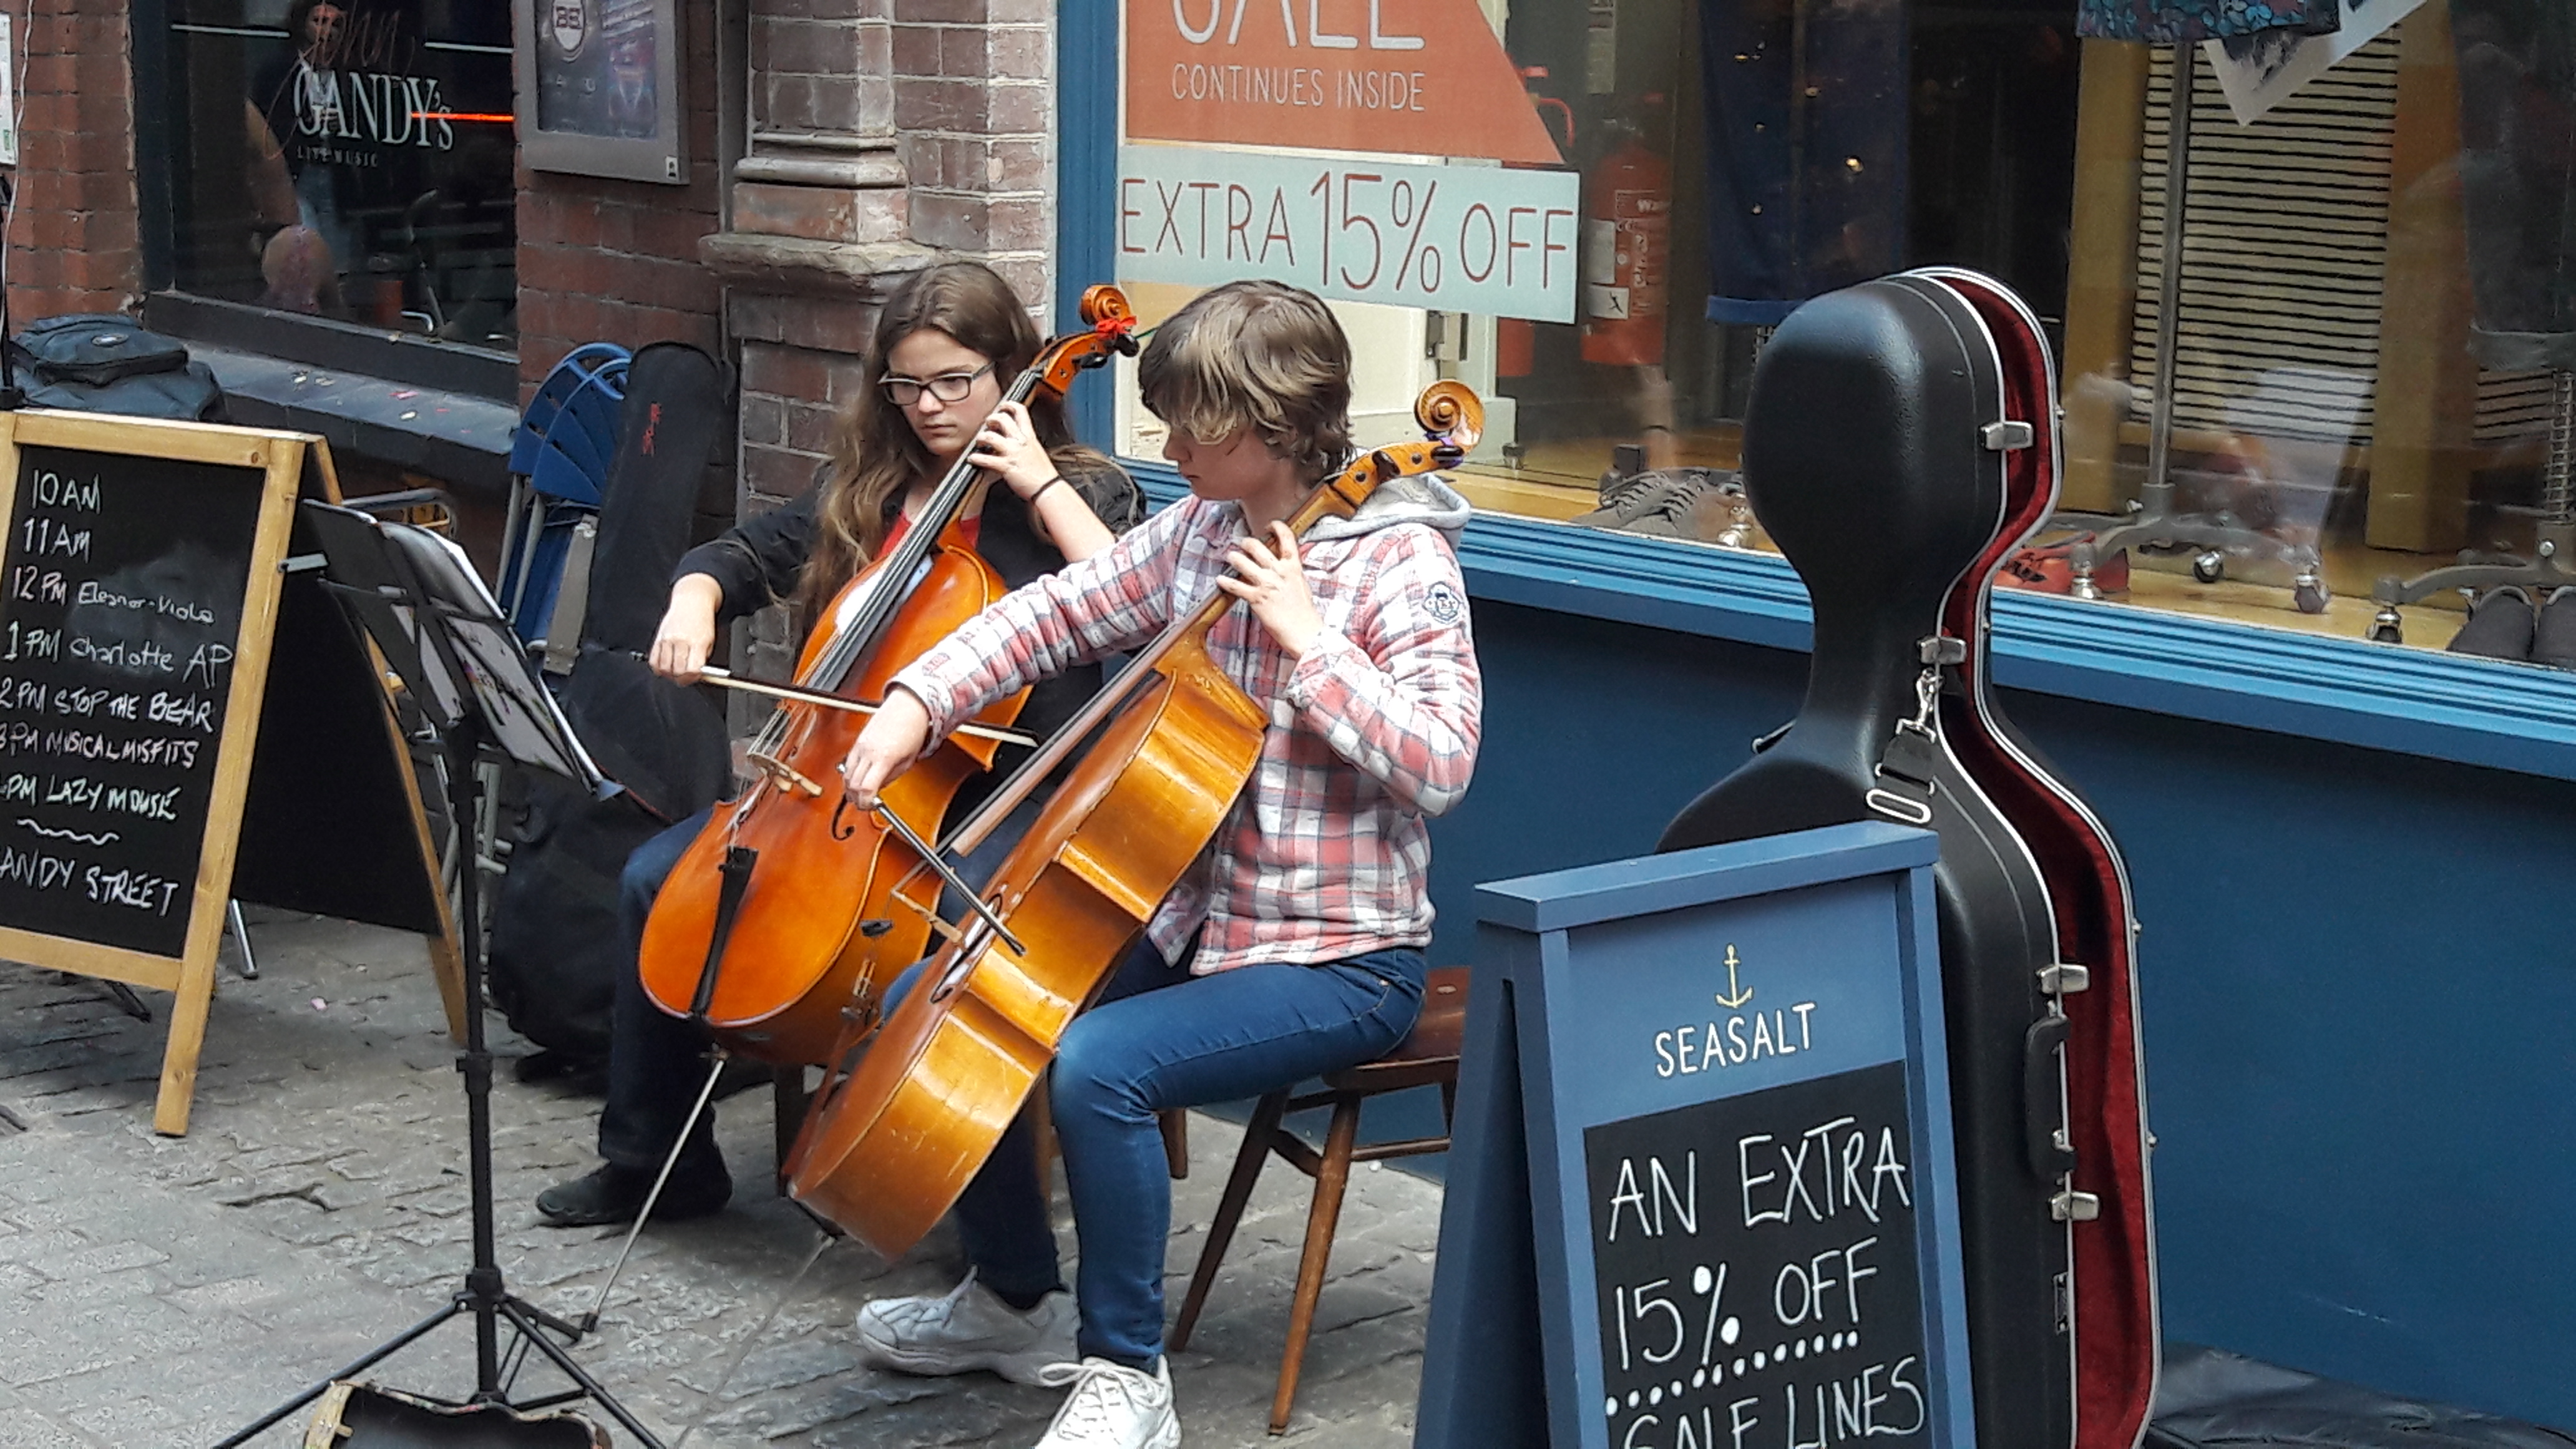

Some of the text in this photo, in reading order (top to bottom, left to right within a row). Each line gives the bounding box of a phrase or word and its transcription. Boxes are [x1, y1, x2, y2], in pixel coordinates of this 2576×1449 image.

[1172, 63, 1425, 112] CONTINUES INSIDE
[1121, 178, 1295, 266] EXTRA
[1310, 170, 1442, 293] 15%
[1460, 202, 1574, 291] OFF
[69, 637, 174, 671] Charlotte
[182, 643, 233, 689] AP
[54, 686, 109, 718] STOP
[109, 693, 140, 720] THE
[148, 691, 214, 733] BEAR
[46, 773, 104, 812] LAZY
[107, 786, 182, 820] MOUSE
[85, 865, 180, 917] STREET
[1654, 1002, 1817, 1078] SEASALT
[1609, 1116, 1911, 1242] AN EXTRA
[1616, 1236, 1878, 1371] 15% OFF
[1787, 1355, 1926, 1449] LINES
